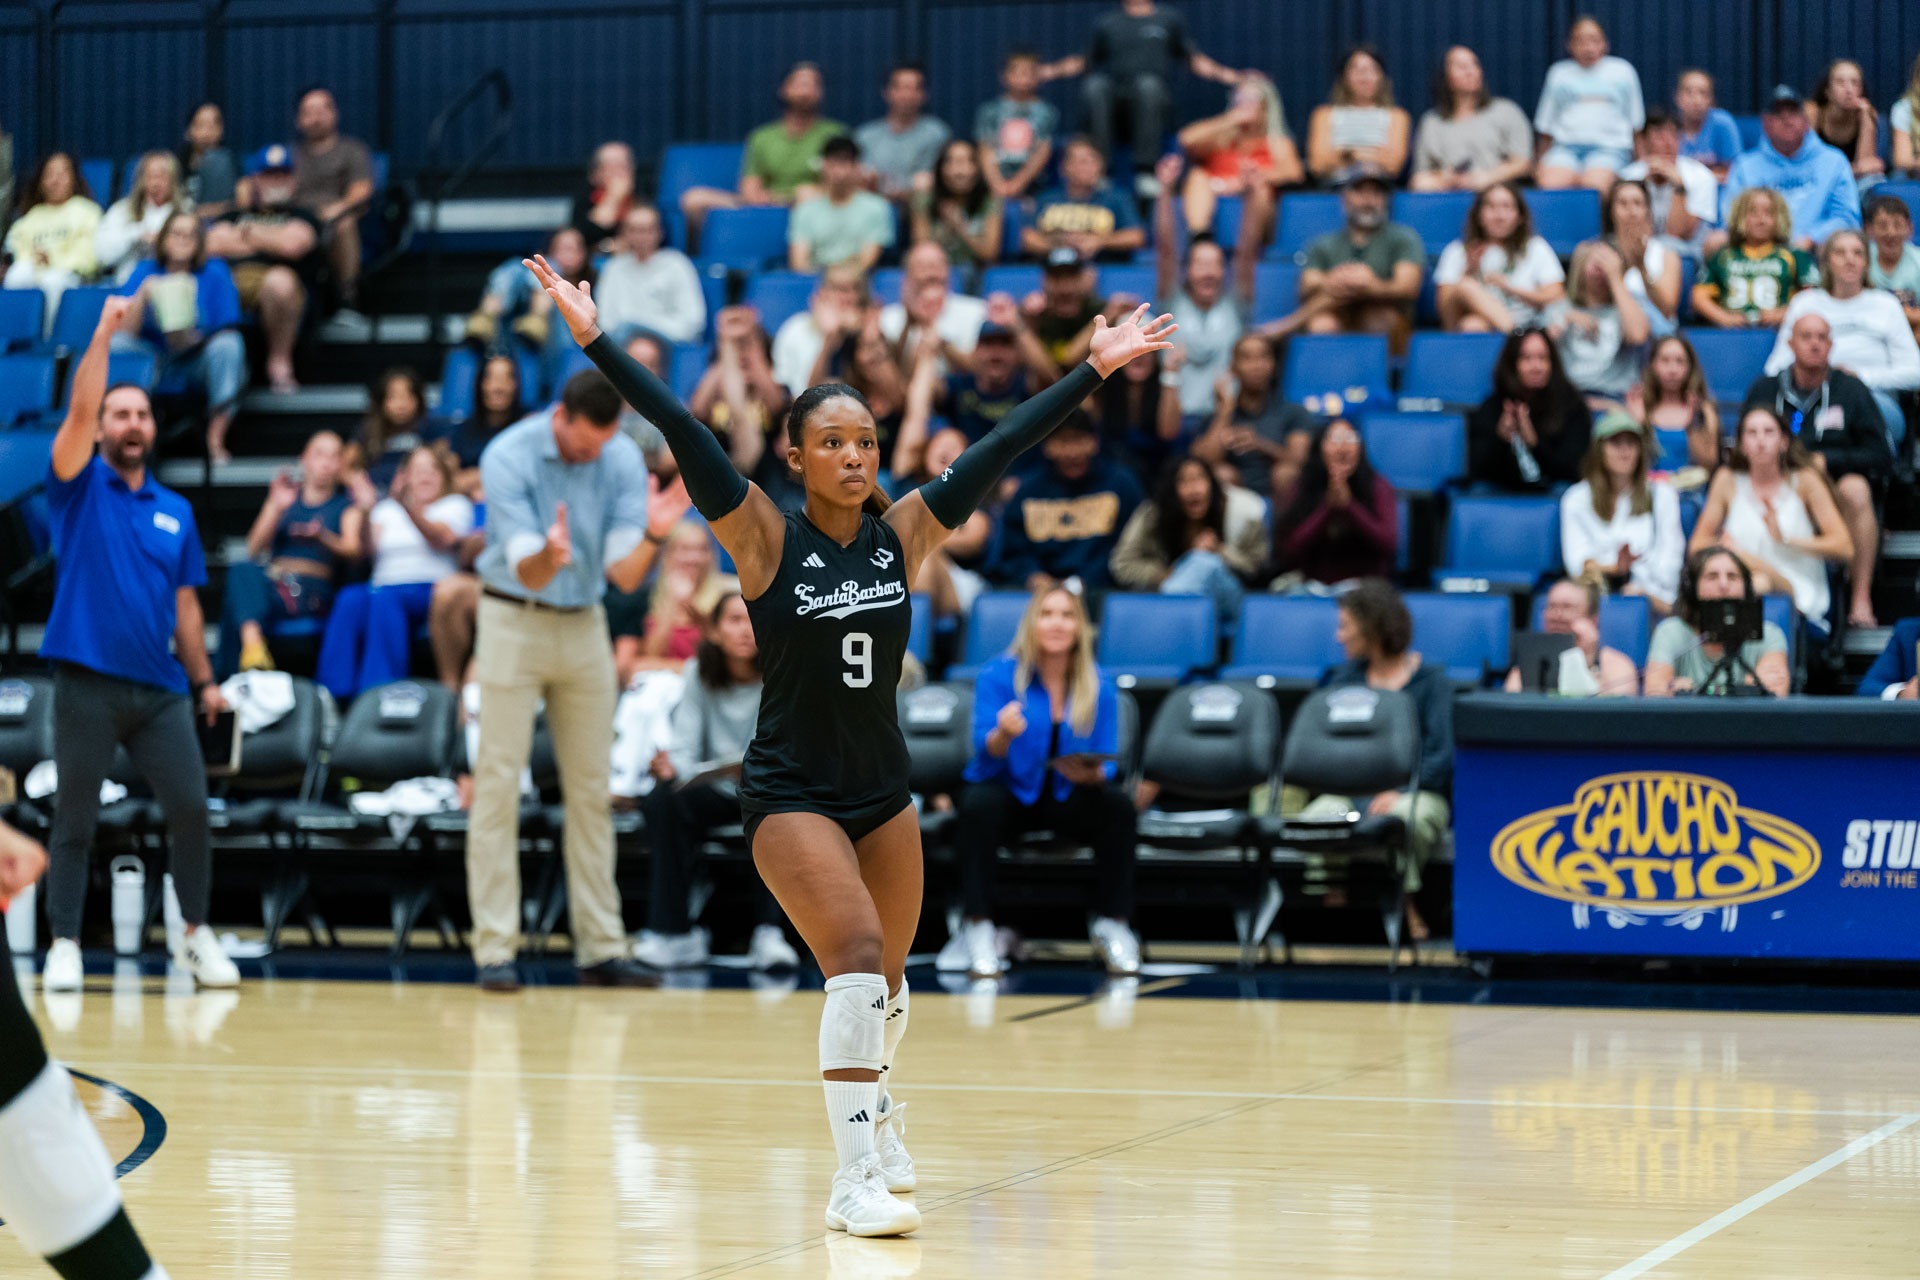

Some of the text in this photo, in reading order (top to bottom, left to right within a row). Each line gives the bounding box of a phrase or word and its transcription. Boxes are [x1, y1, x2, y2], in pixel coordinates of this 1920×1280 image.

[842, 632, 873, 688] 9
[1573, 776, 1741, 857] GAUCHO
[1502, 817, 1812, 900] NATION
[1840, 870, 1917, 888] JOIN THE
